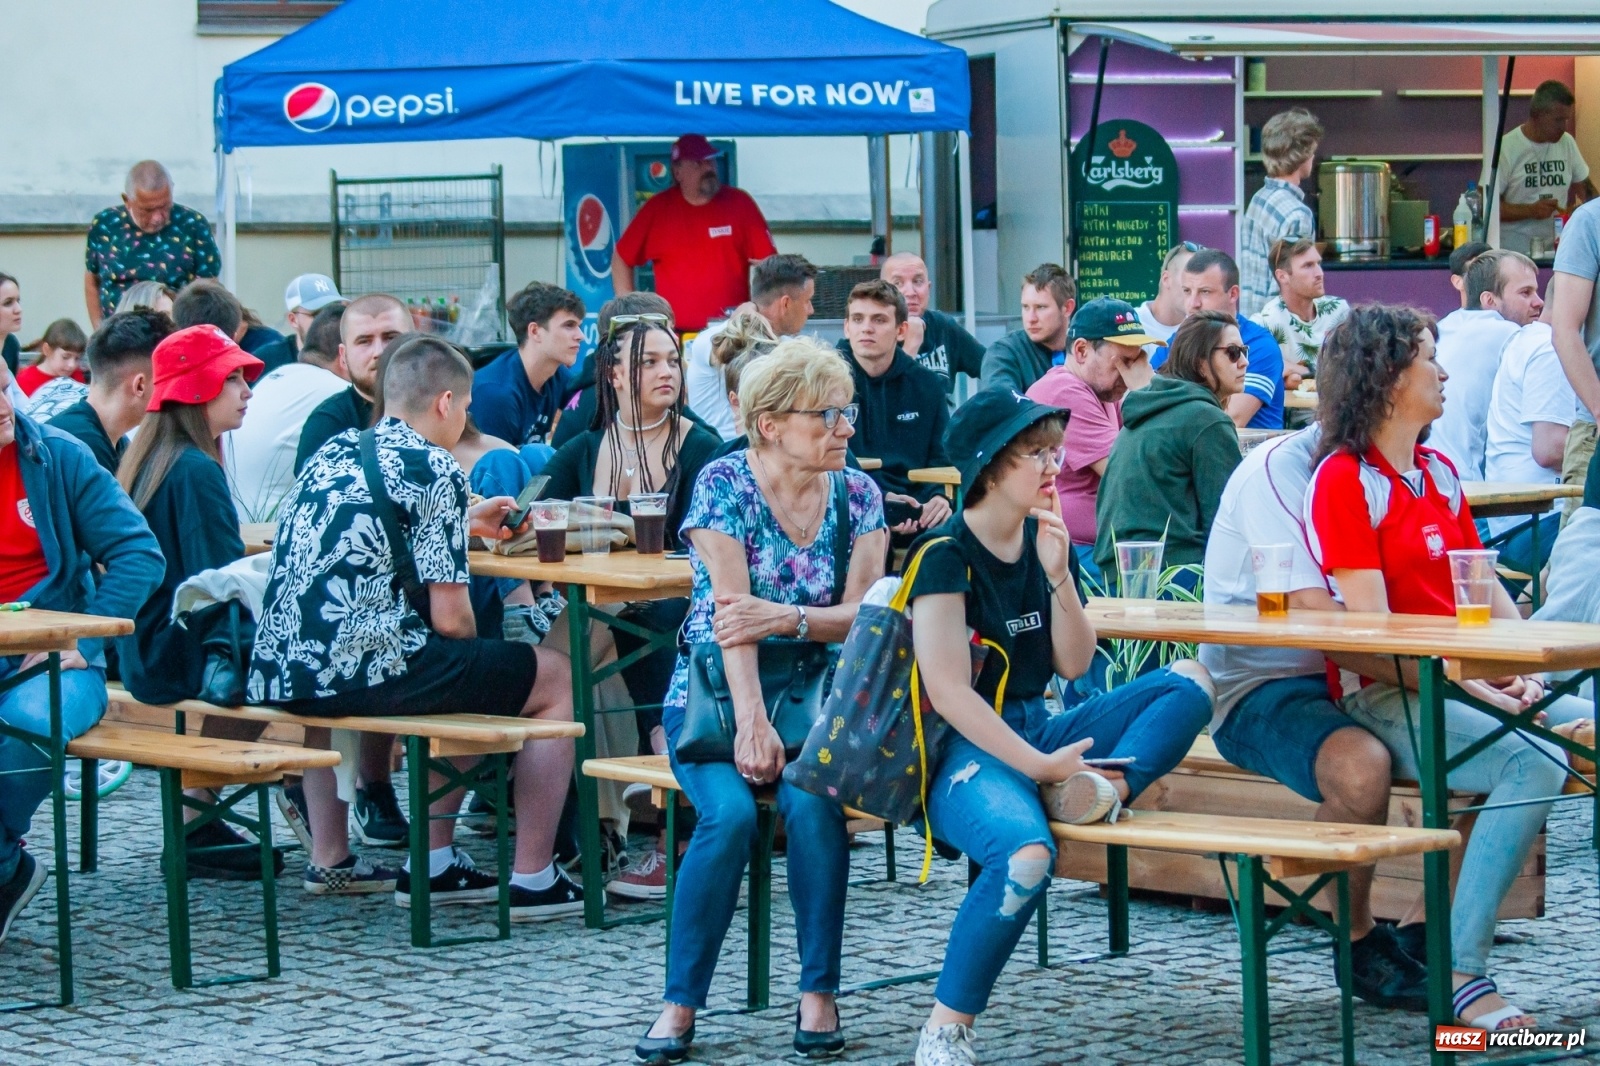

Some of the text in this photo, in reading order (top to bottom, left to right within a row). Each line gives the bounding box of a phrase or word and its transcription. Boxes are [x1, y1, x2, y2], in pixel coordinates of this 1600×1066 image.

[675, 80, 743, 105] LIVE
[752, 84, 817, 106] FOR
[825, 81, 904, 105] NOW
[346, 87, 455, 126] pepsi
[1082, 155, 1164, 191] Carlsberg
[1524, 160, 1565, 174] BE KETO
[1525, 174, 1566, 188] BE COOL
[1157, 219, 1168, 232] 15
[1157, 234, 1167, 247] 15
[1079, 267, 1103, 276] KAWA
[1080, 279, 1120, 288] HERBATA
